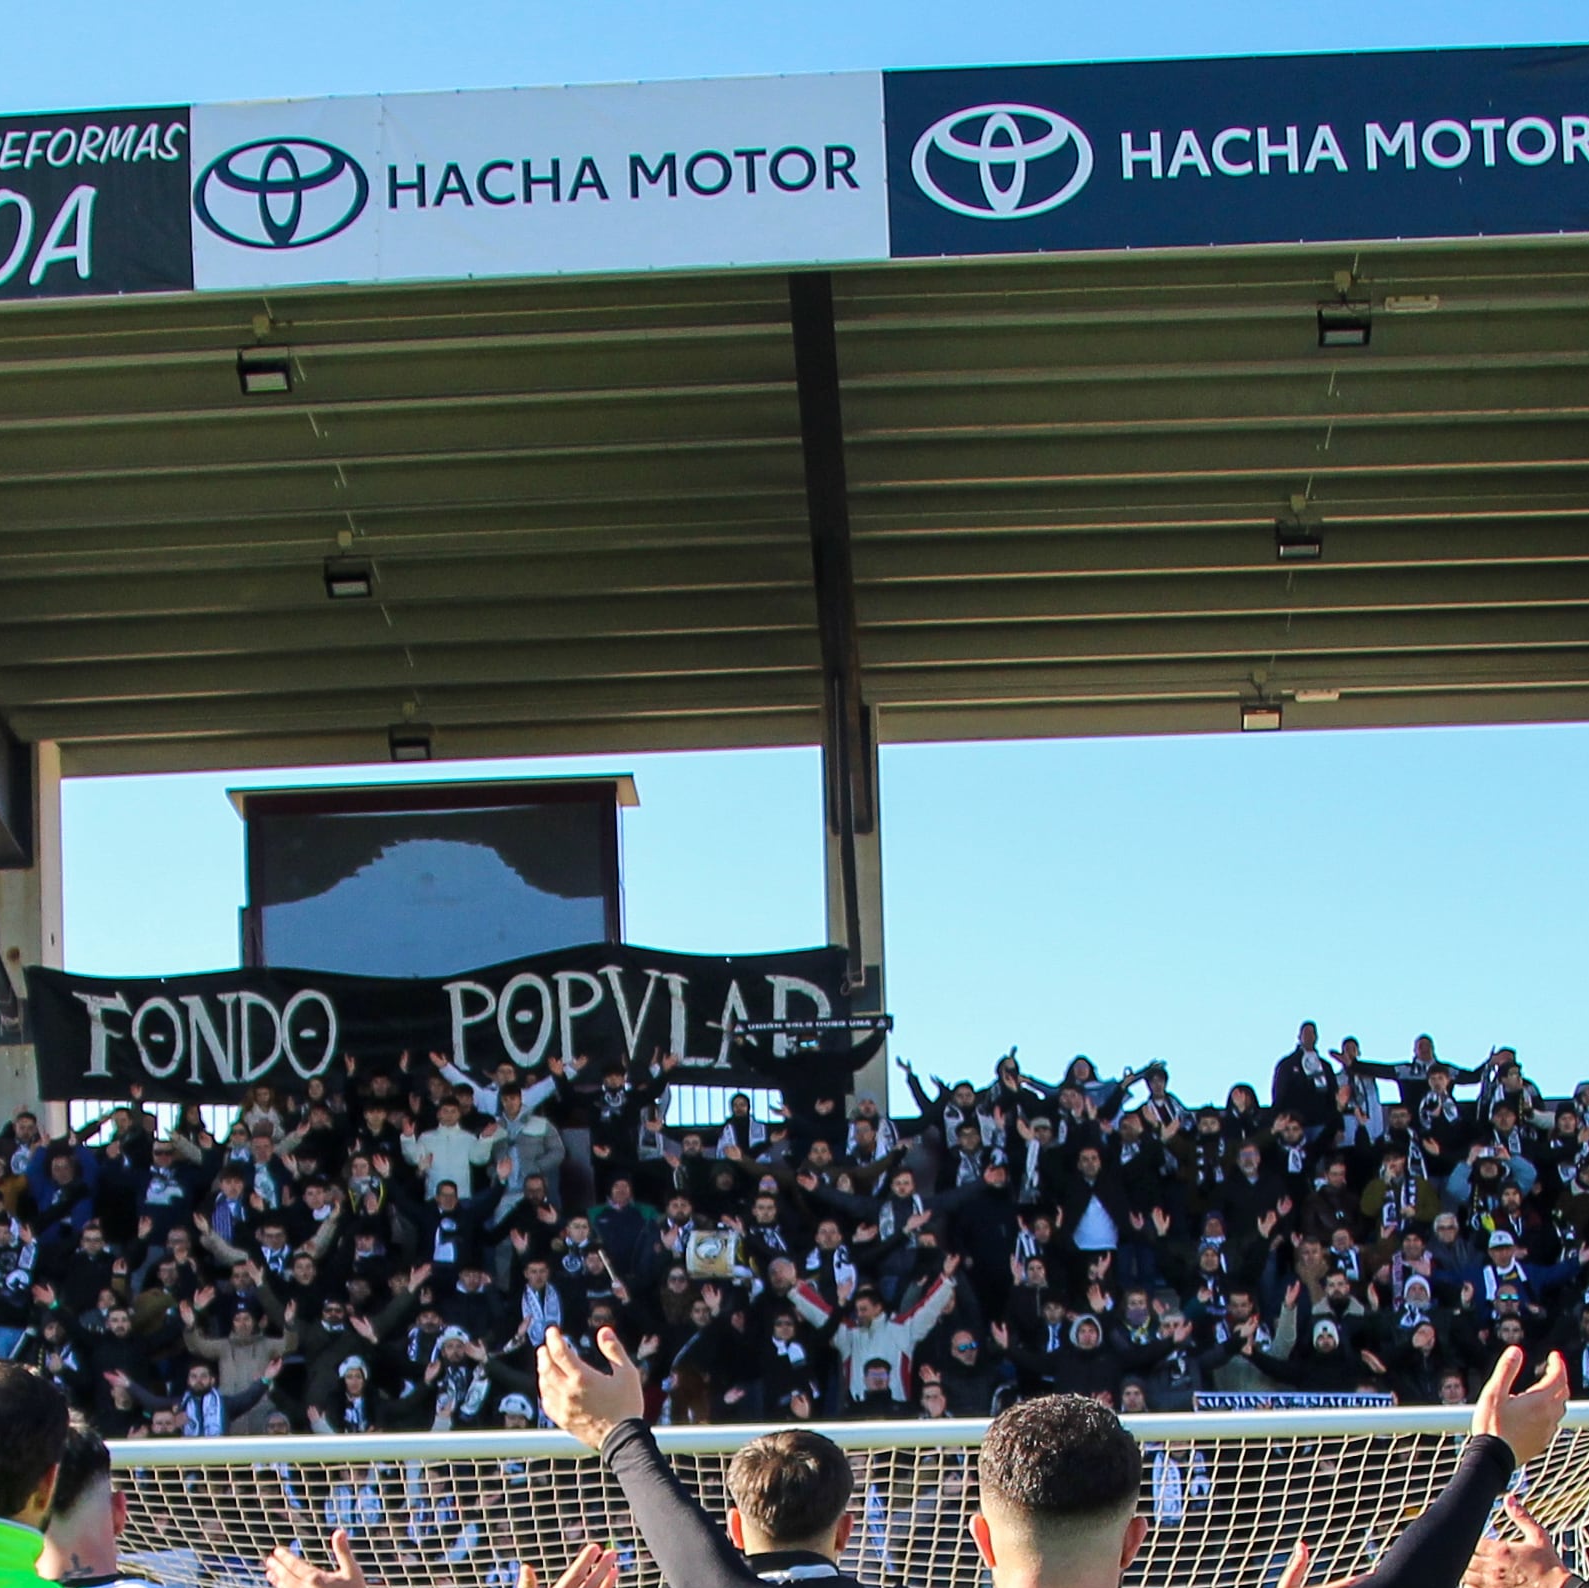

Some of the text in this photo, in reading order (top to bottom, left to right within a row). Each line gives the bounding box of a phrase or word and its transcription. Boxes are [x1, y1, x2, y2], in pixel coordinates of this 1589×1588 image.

[387, 144, 860, 209] HACHA MOTOR
[1120, 124, 1348, 179] HACHA
[73, 990, 338, 1085] FONDO
